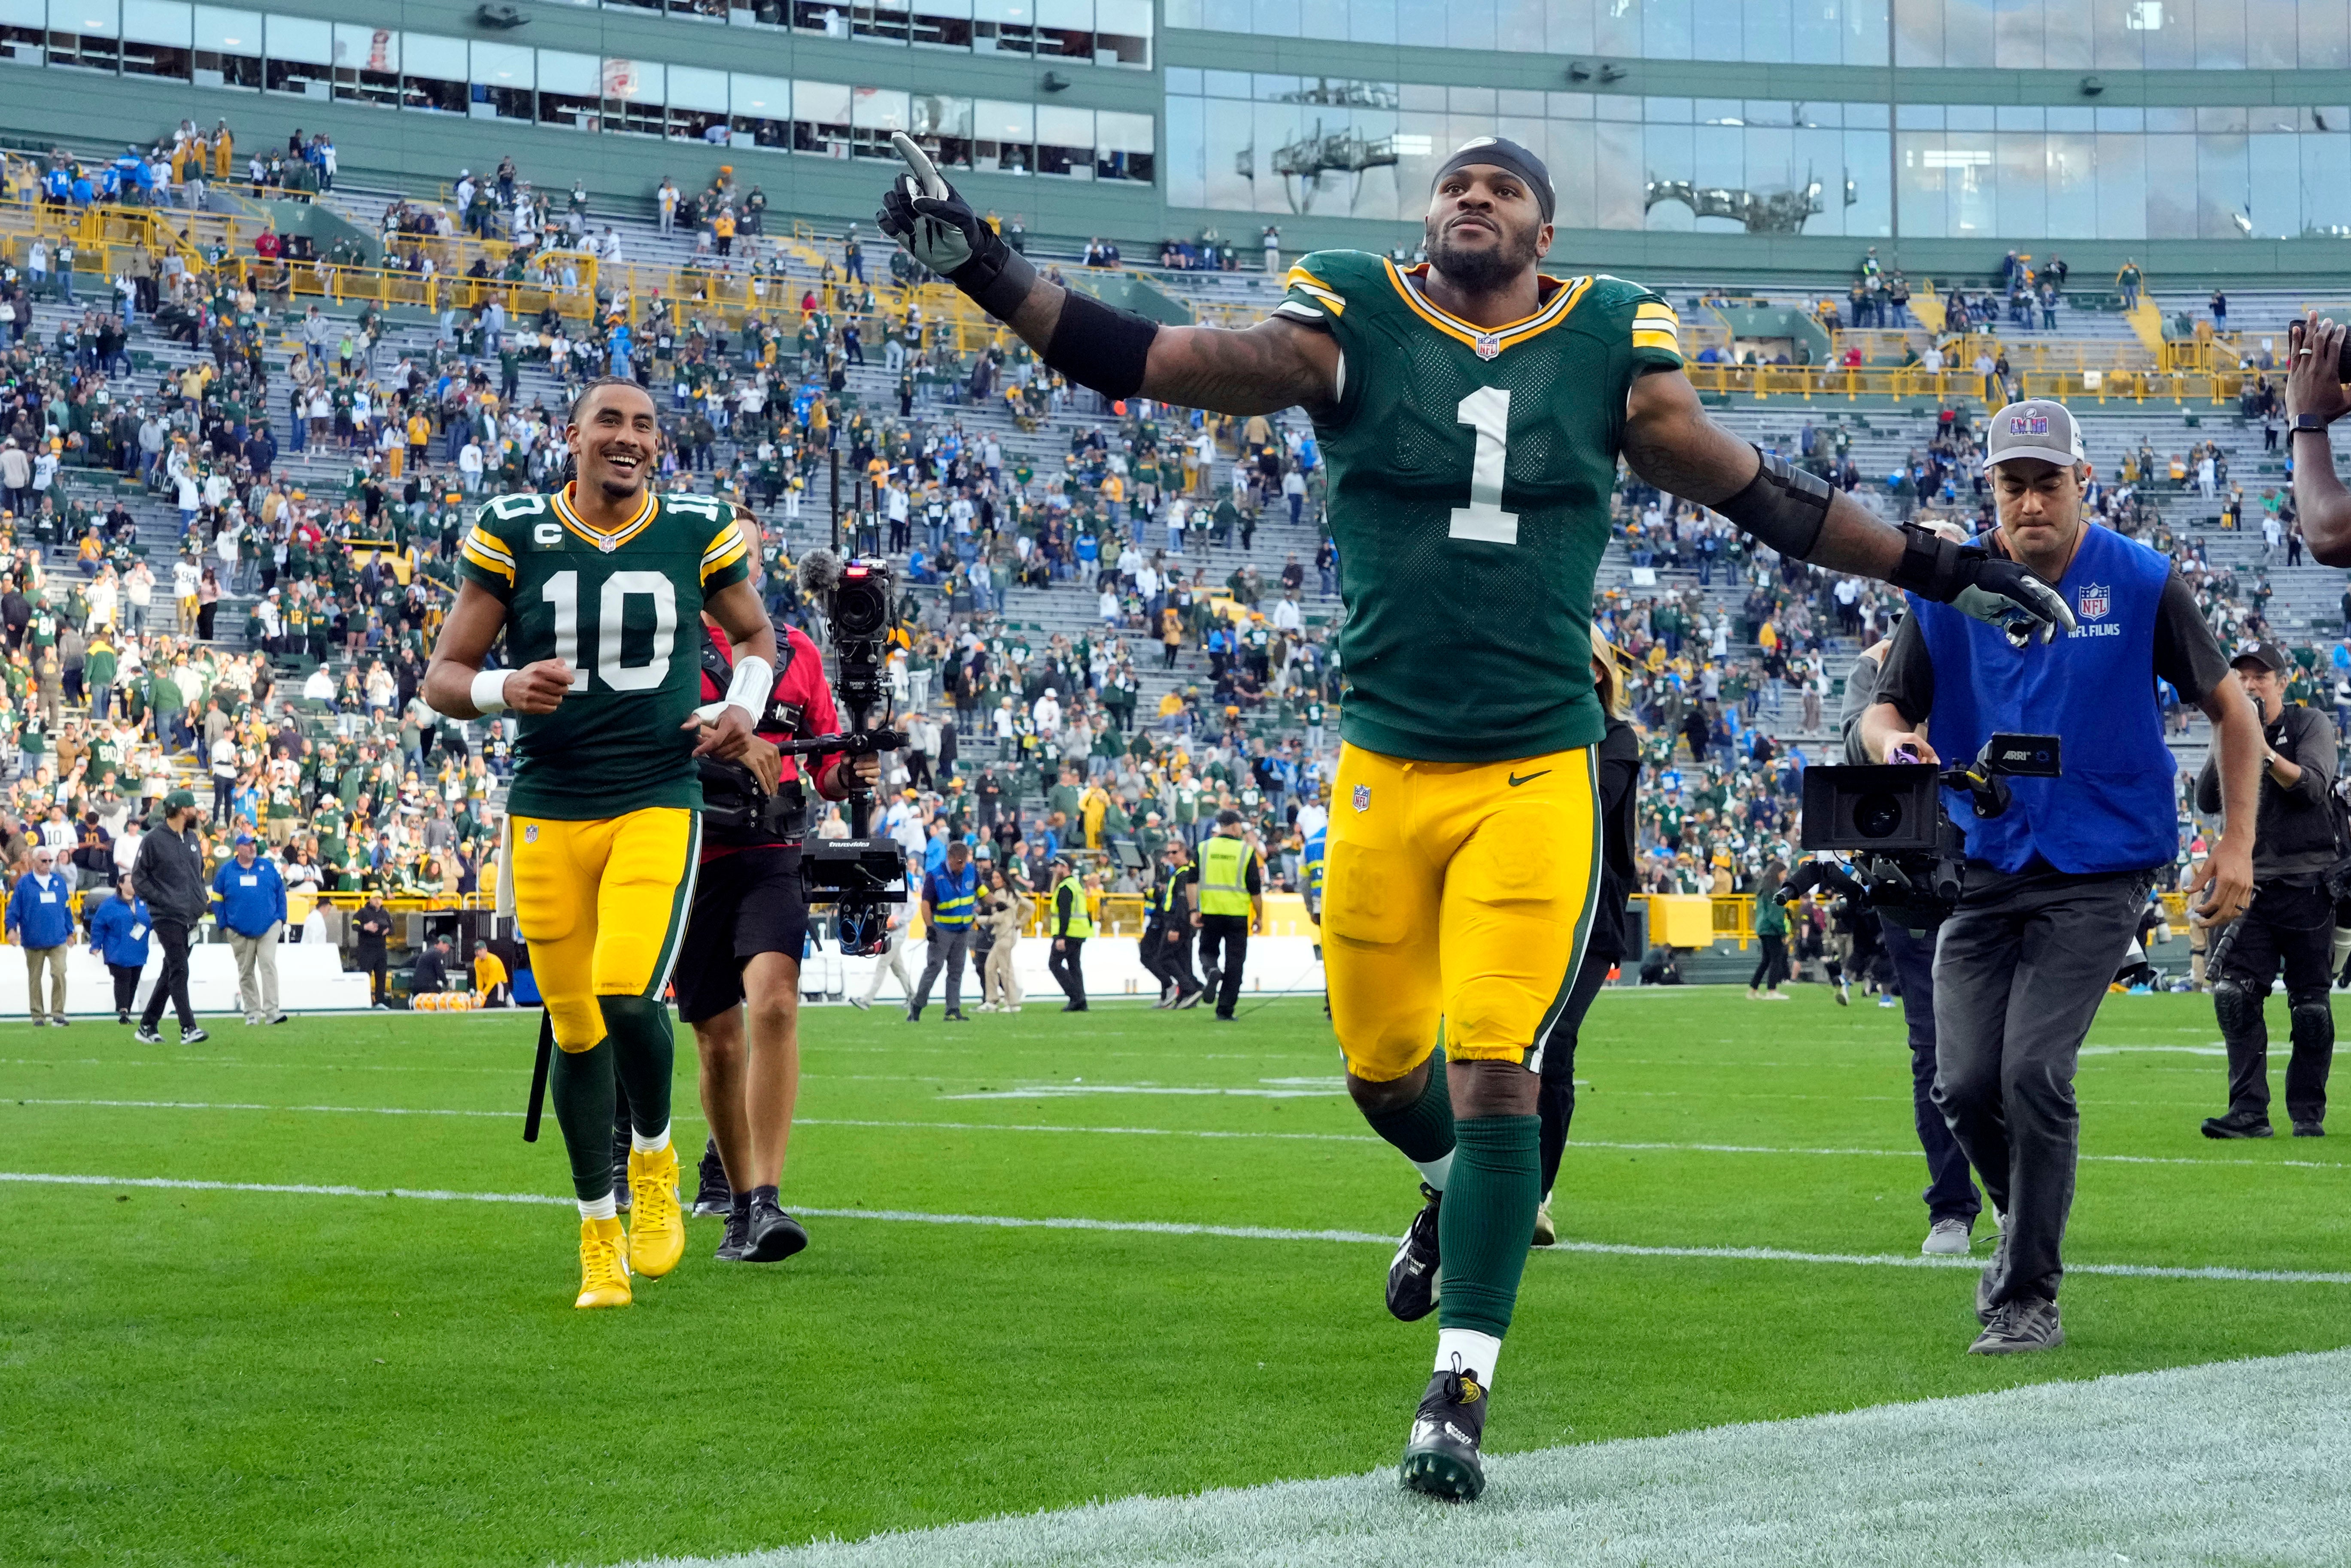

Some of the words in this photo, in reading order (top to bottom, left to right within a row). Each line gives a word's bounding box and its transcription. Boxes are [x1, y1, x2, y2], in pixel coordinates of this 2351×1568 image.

[58, 174, 67, 185] 14
[1480, 344, 1495, 355] NFL
[1448, 386, 1519, 544] 1
[420, 477, 431, 492] 10
[485, 493, 546, 520] 0
[535, 523, 562, 544] C
[2083, 599, 2106, 615] NFL
[291, 610, 302, 624] 12
[39, 617, 55, 636] 84
[543, 571, 677, 691] 10
[2089, 623, 2120, 636] FILMS
[99, 745, 116, 762] 80
[494, 742, 506, 756] 50
[2002, 751, 2026, 760] ARRI
[244, 794, 255, 811] 14
[1355, 795, 1366, 807] NFL
[48, 830, 62, 845] 10
[85, 833, 100, 845] 10
